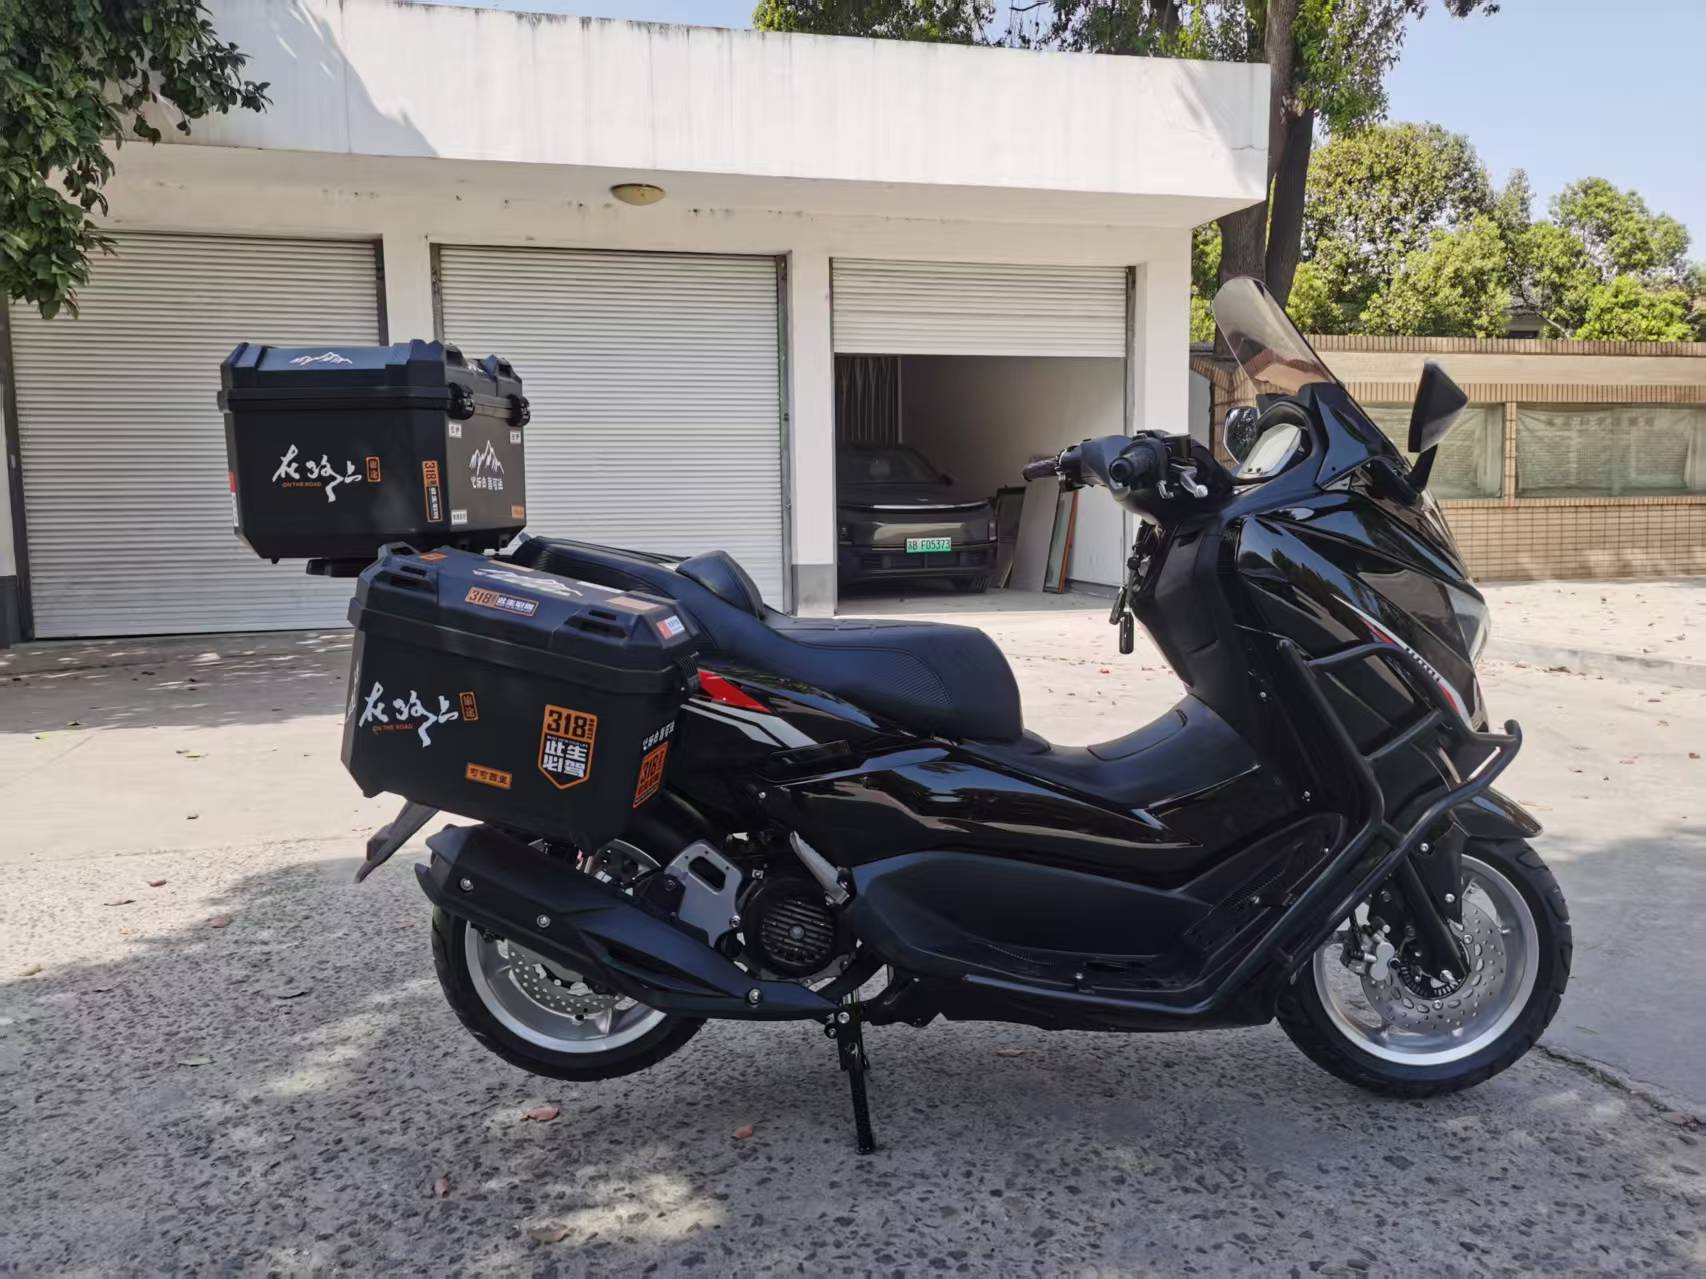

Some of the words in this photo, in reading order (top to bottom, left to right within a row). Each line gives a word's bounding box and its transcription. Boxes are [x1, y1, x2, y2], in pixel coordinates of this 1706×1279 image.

[272, 444, 362, 503] 在路上
[425, 462, 437, 480] 318
[469, 589, 492, 604] 318
[358, 681, 459, 748] 在路上
[547, 710, 587, 737] 318
